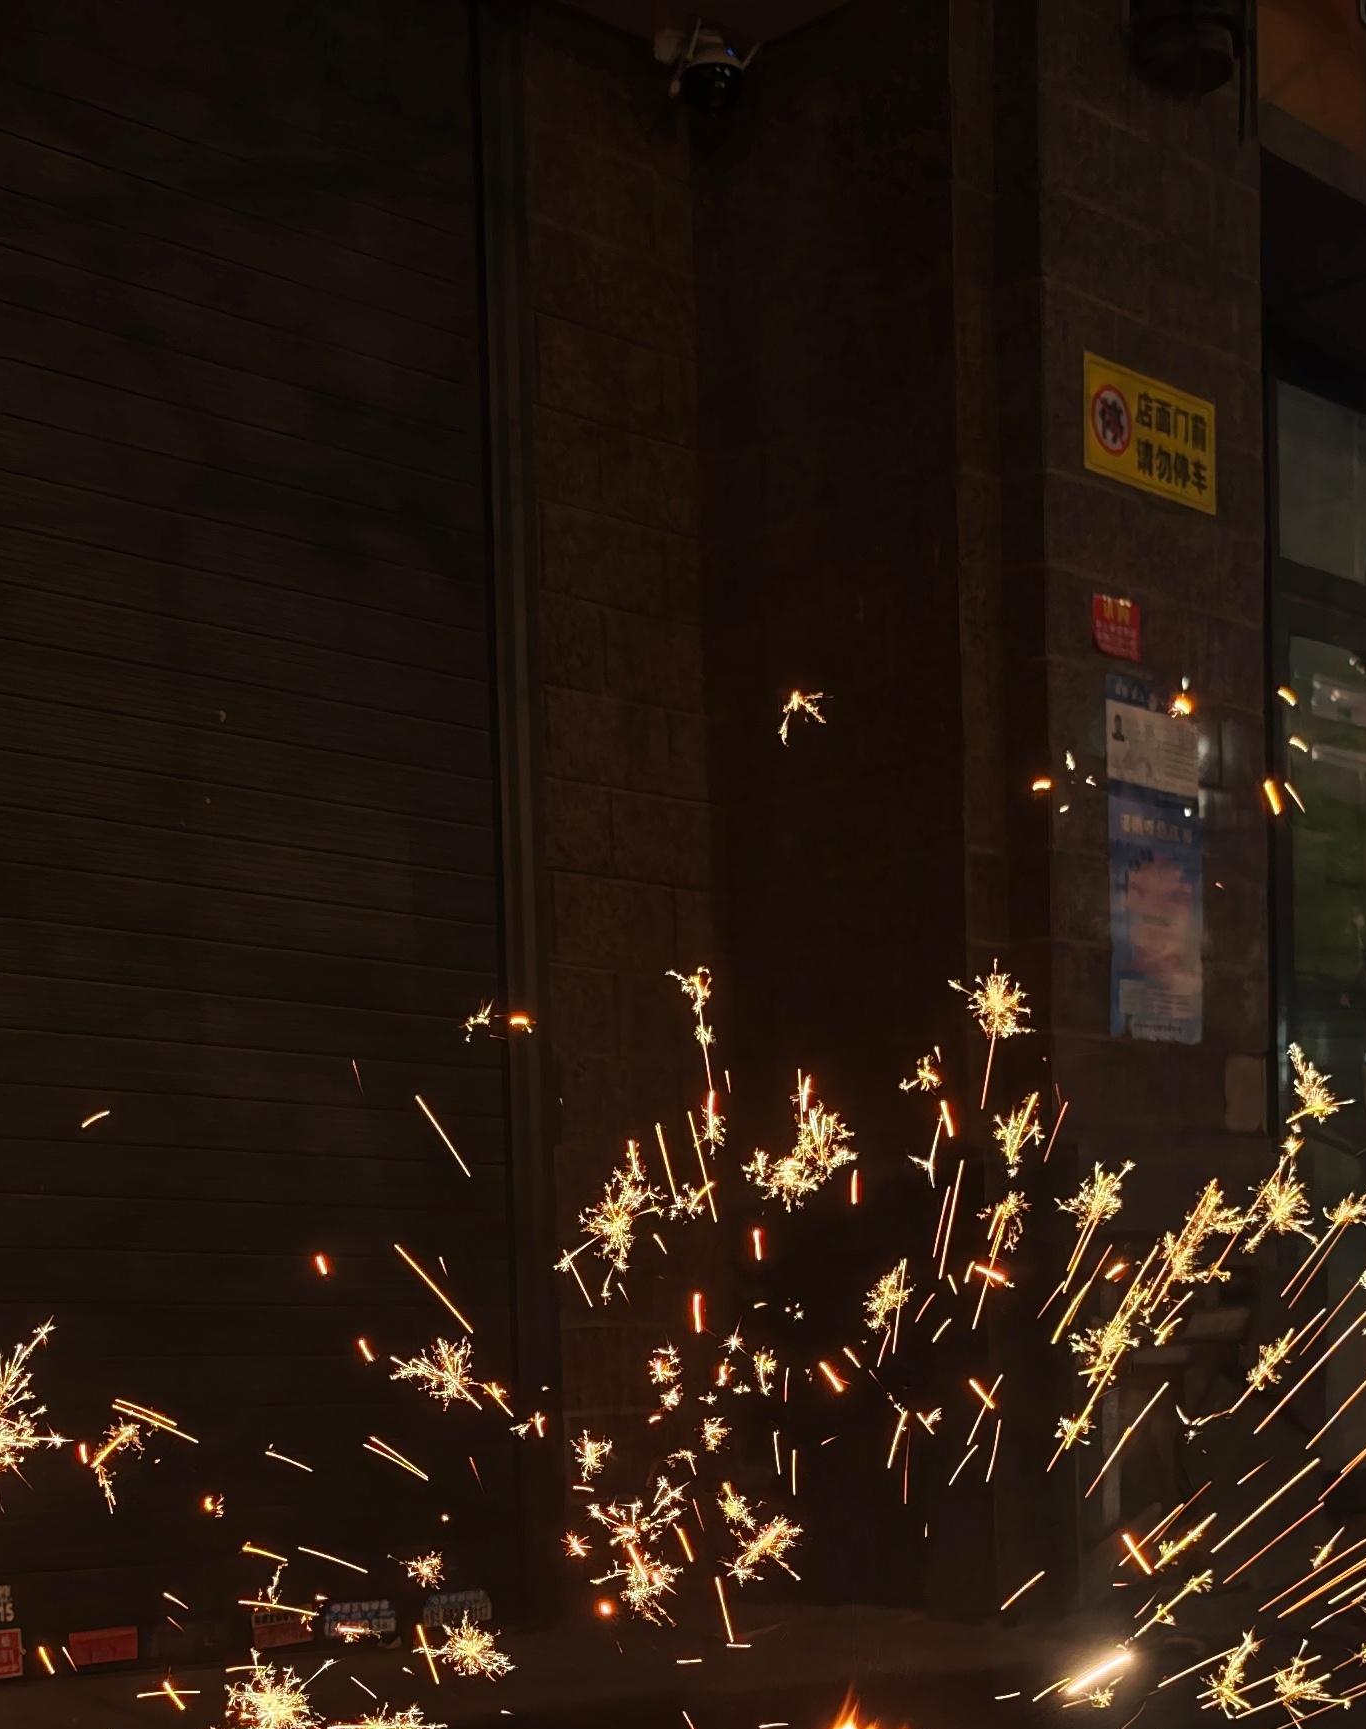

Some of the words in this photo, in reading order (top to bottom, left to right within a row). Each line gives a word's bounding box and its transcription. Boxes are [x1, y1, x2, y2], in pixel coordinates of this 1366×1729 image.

[1136, 392, 1206, 452] 店面门前
[1137, 438, 1207, 495] 请勿停车
